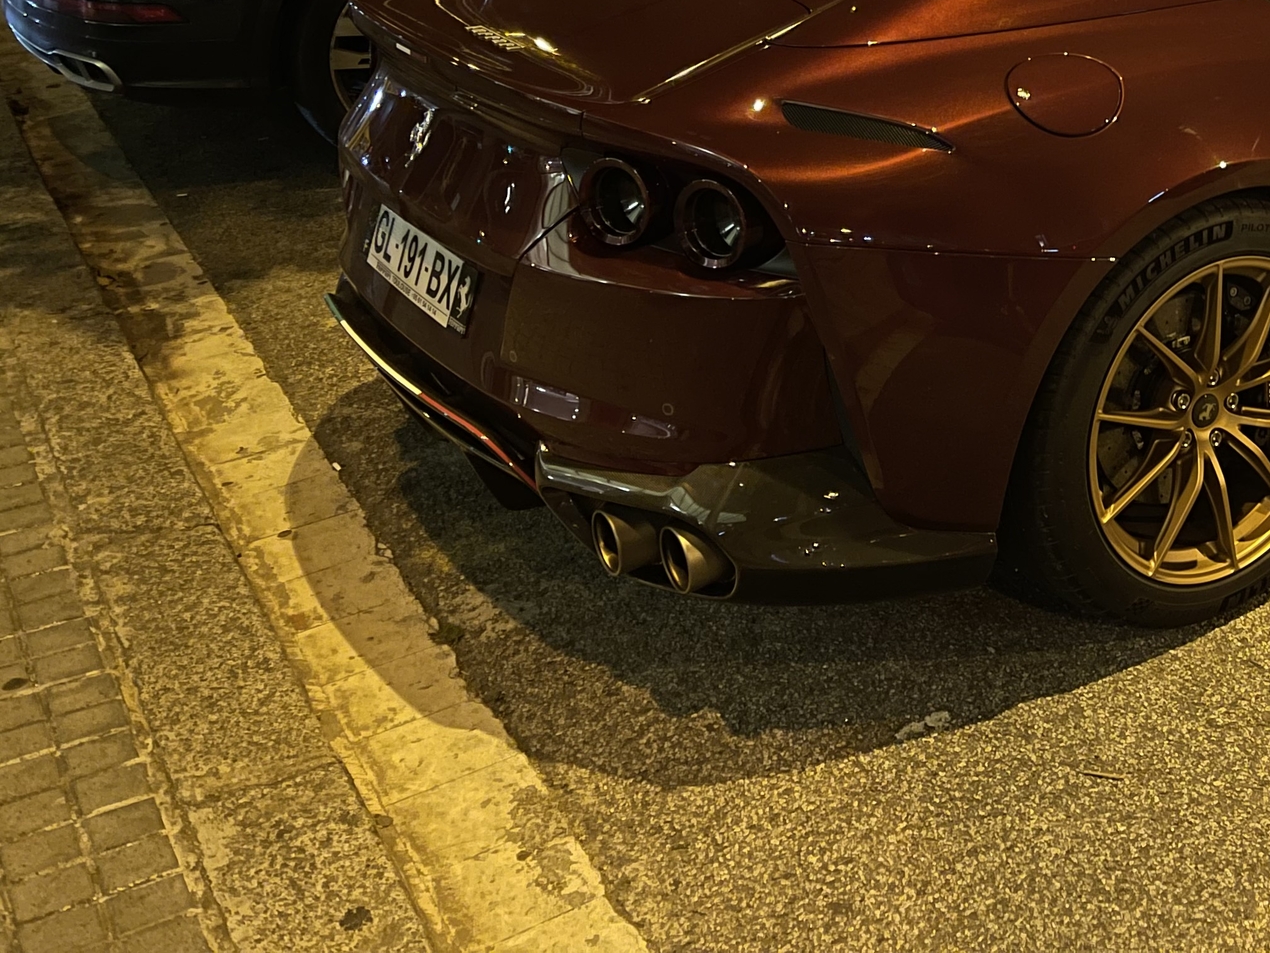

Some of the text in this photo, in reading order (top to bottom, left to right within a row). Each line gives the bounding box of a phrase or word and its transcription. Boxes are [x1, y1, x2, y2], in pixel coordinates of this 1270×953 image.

[374, 210, 461, 311] GL-191-BX
[1117, 222, 1227, 311] MICHELIN
[1241, 222, 1270, 232] PILOT
